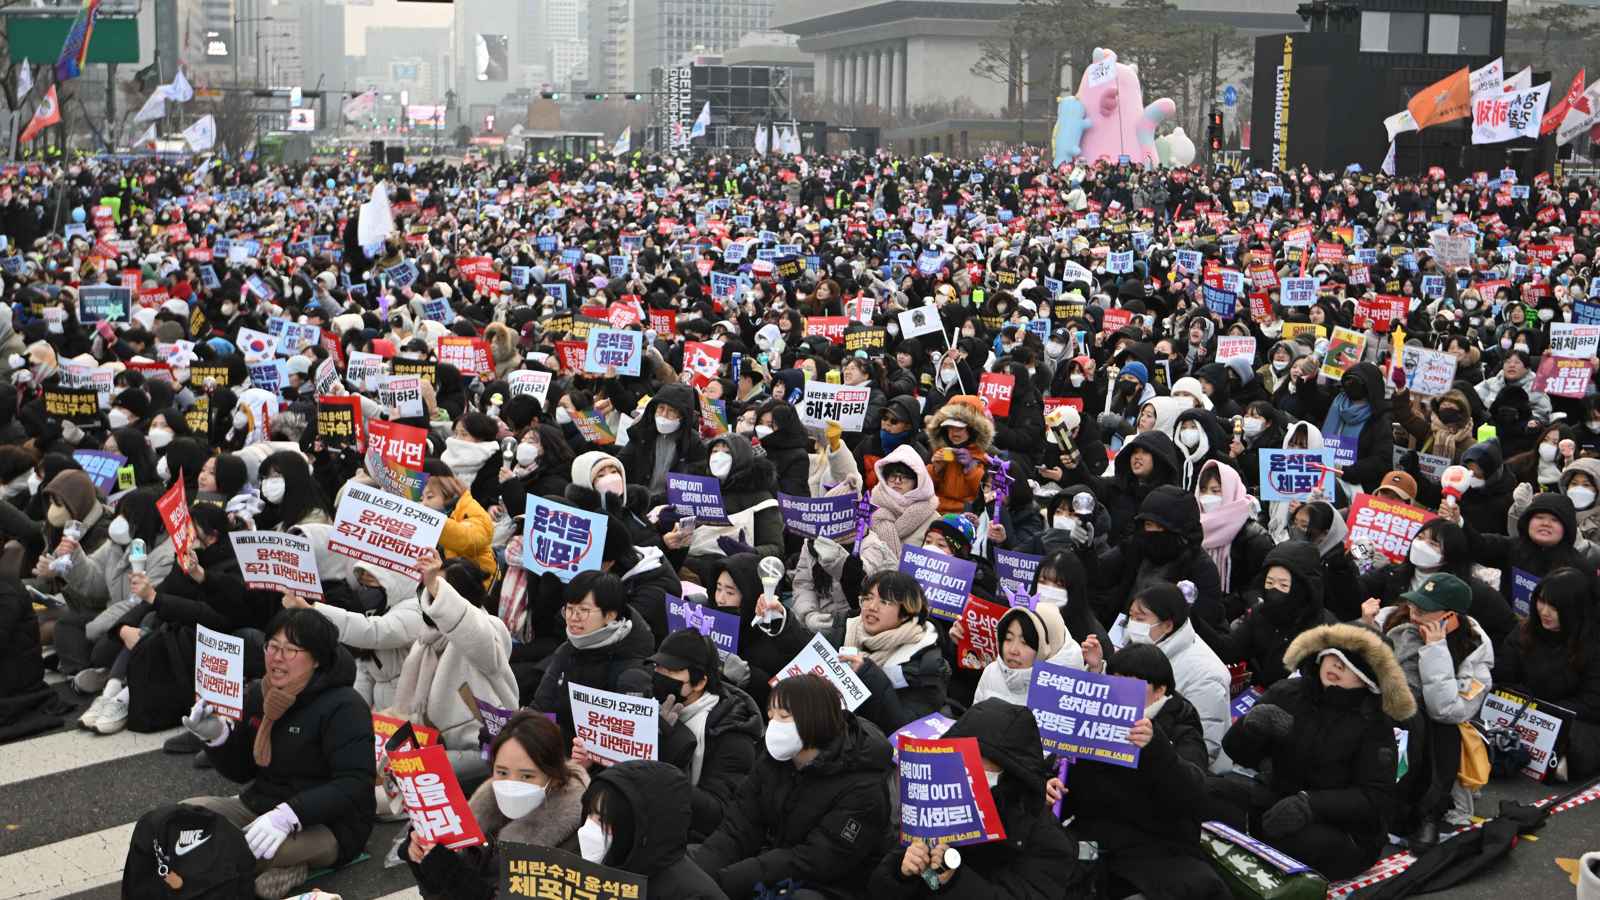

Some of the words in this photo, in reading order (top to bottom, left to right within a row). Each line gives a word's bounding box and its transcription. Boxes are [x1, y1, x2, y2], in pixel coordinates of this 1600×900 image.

[597, 333, 634, 350] 윤석열
[1551, 335, 1597, 350] 해체하라
[600, 350, 628, 368] 체포!
[984, 381, 1011, 401] 파면
[1545, 377, 1589, 393] 체포!
[807, 391, 833, 401] 내란동조
[806, 401, 864, 421] 해체하라
[385, 438, 424, 466] 파면
[1270, 453, 1324, 472] 윤석열
[687, 481, 703, 493] OUT!
[348, 488, 402, 513] 페미니스트가
[402, 506, 441, 528] 요구한다
[701, 494, 719, 504] OUT!
[810, 502, 833, 512] OUT!
[359, 509, 417, 538] 윤석열을
[533, 504, 592, 545] 윤석열
[830, 508, 854, 522] OUT!
[337, 520, 365, 542] 즉각
[236, 535, 282, 546] 페미니스트가
[283, 538, 310, 553] 요구한다
[536, 535, 582, 571] 체포!
[256, 548, 300, 568] 윤석열을
[904, 551, 927, 569] 윤석열
[926, 557, 949, 573] OUT!
[245, 561, 271, 576] 즉각
[272, 563, 317, 585] 파면하라!
[940, 573, 967, 592] OUT!
[924, 586, 965, 609] 사회로!
[218, 638, 241, 655] 요구한다
[710, 631, 733, 648] OUT!
[201, 652, 229, 675] 윤석열을
[812, 641, 846, 681] 페미니스트가
[841, 674, 864, 701] 요구한다
[203, 674, 240, 699] 파면하라!
[1037, 671, 1074, 694] 윤석열
[1074, 680, 1110, 700] OUT!
[572, 690, 617, 711] 페미니스트가
[618, 700, 654, 717] 요구한다
[1058, 695, 1101, 717] 성차별
[1100, 702, 1137, 722] OUT!
[587, 710, 635, 737] 윤석열을
[1031, 708, 1077, 735] 성평등
[576, 724, 598, 745] 즉각
[599, 732, 653, 761] 파면하라!
[911, 763, 932, 782] OUT!
[907, 782, 929, 801] 성차별
[929, 782, 963, 801] OUT!
[919, 804, 973, 829] 사회로!
[180, 829, 204, 846] NIKE
[510, 859, 581, 888] 내란수괴
[584, 875, 640, 900] 윤석열
